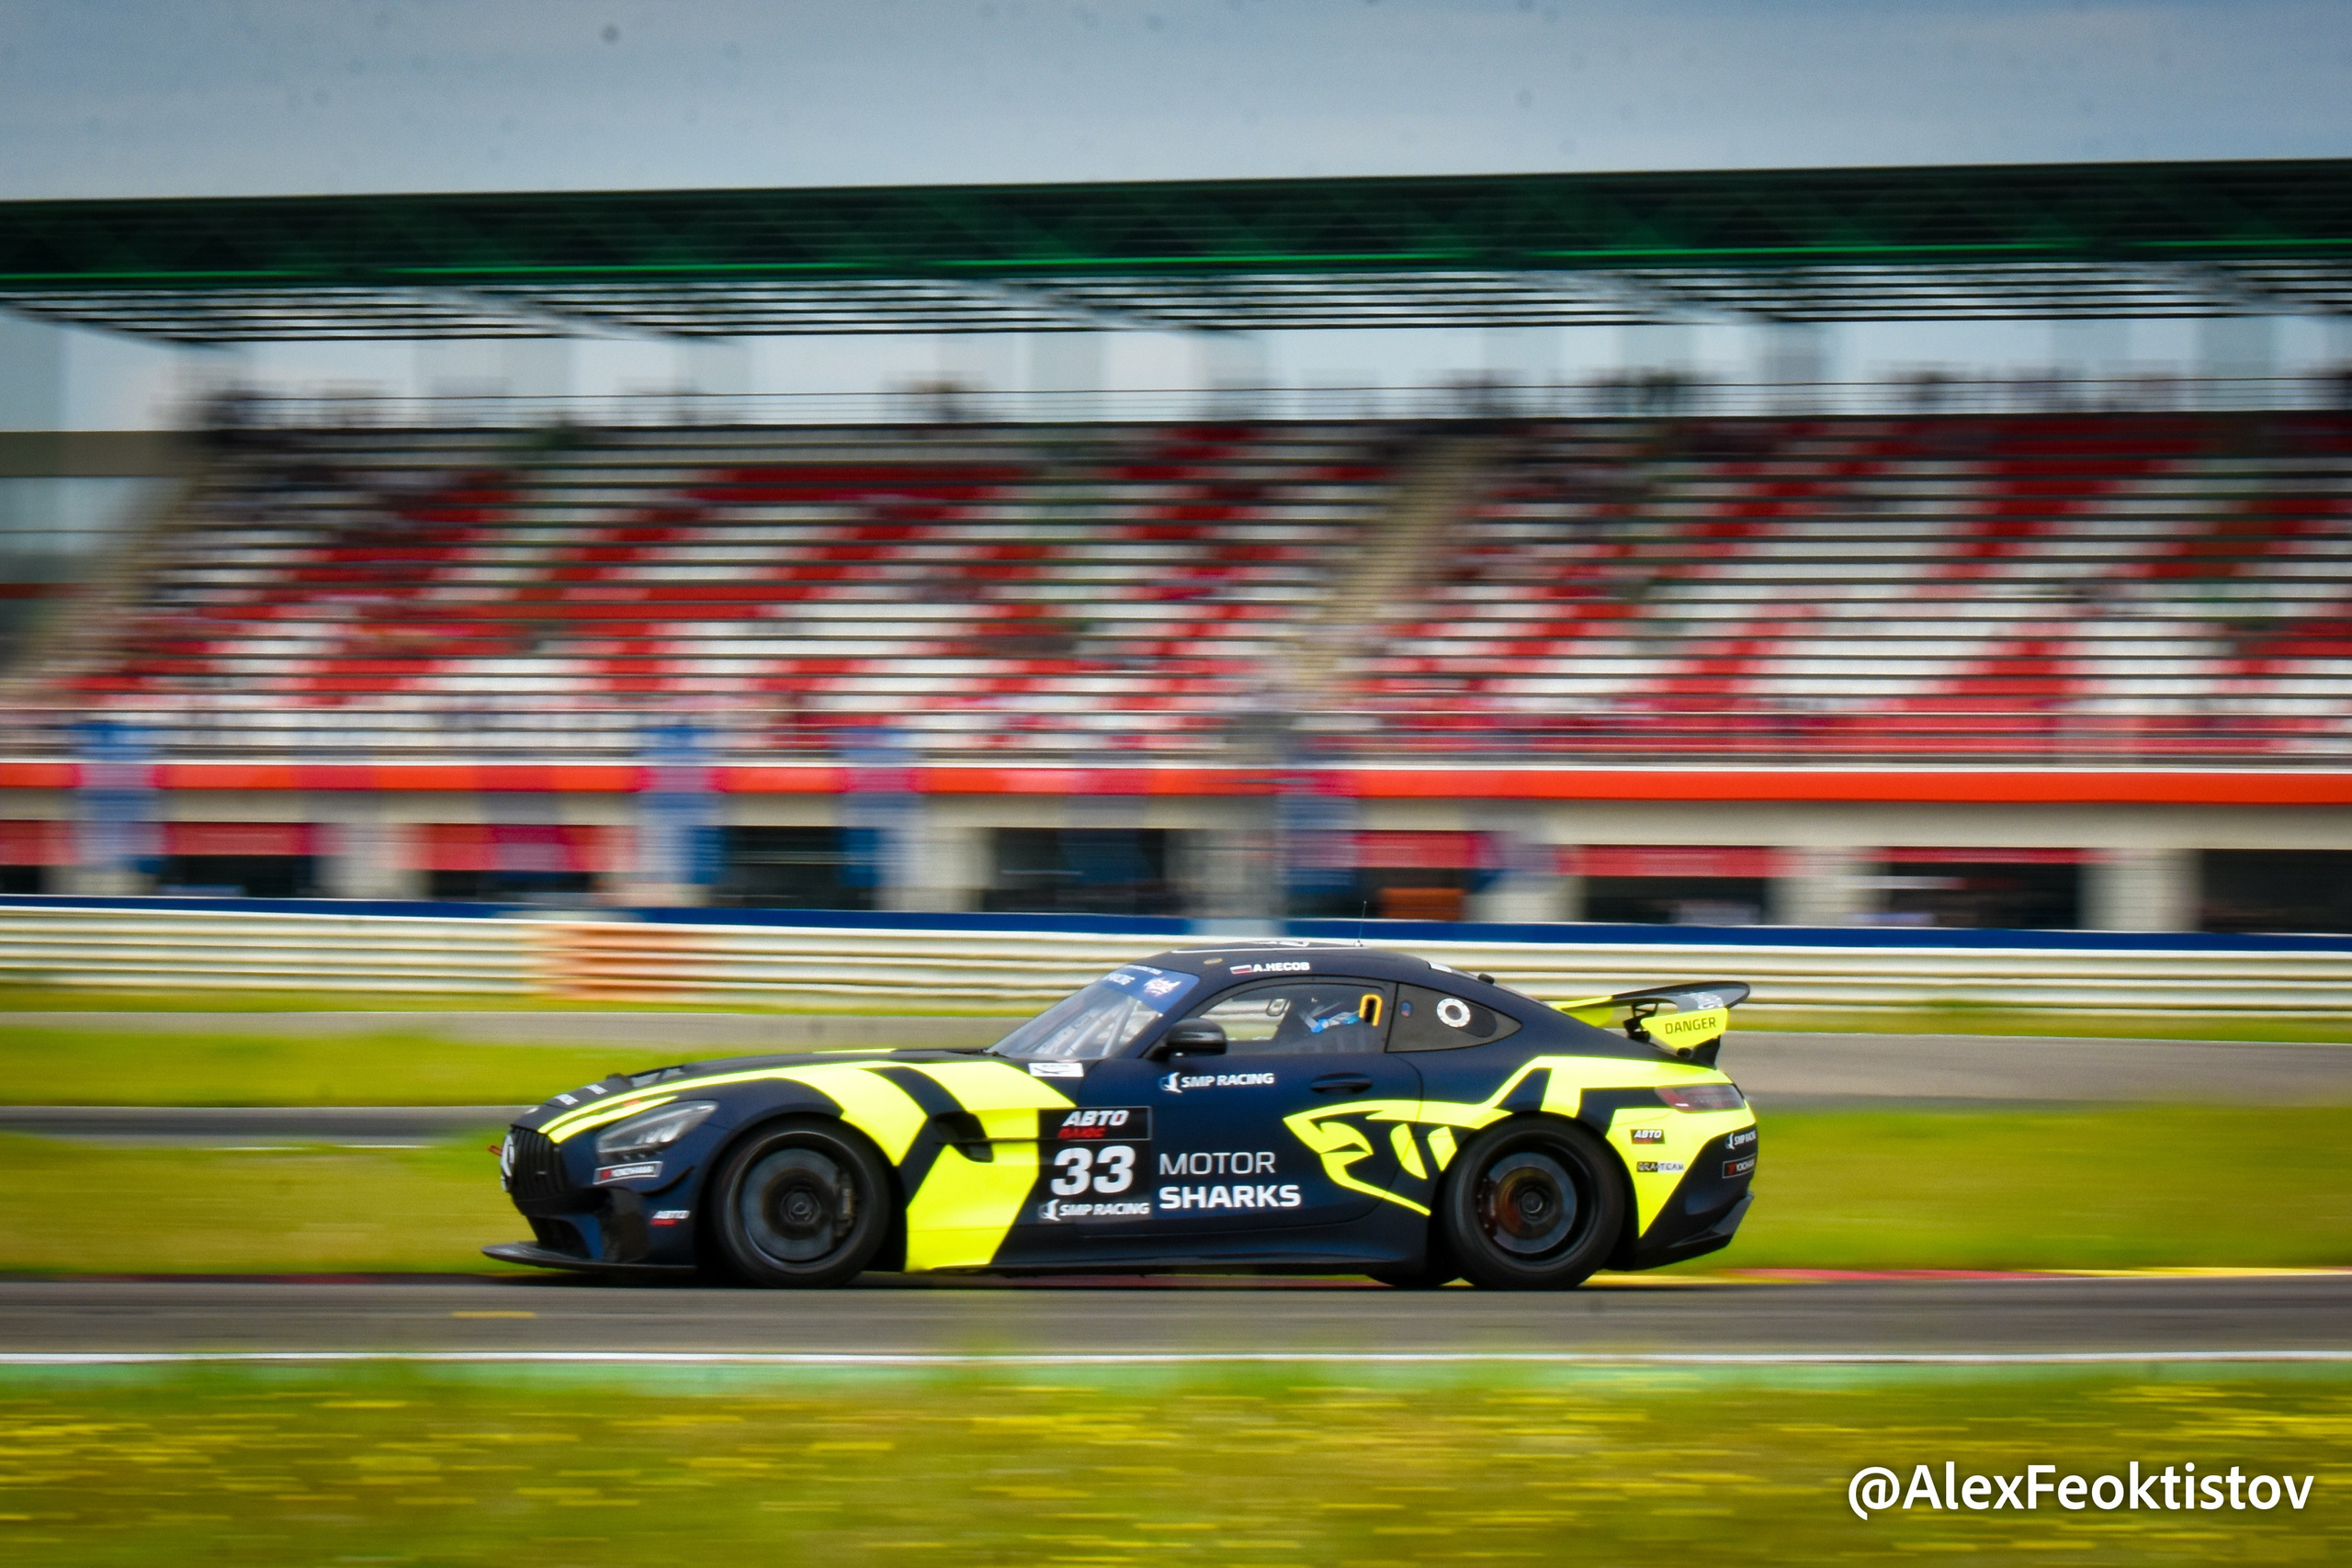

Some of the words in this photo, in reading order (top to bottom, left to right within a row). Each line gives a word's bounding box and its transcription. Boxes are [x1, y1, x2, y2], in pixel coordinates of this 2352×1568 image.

[1664, 1016, 1717, 1035] DANGER
[1181, 1075, 1216, 1088] SMP
[1216, 1072, 1275, 1086] RACING
[1050, 1145, 1136, 1196] 33
[1159, 1151, 1276, 1176] MOTOR
[1159, 1184, 1302, 1210] SHARKS
[1058, 1203, 1093, 1216] SMP
[1093, 1201, 1150, 1215] RACING
